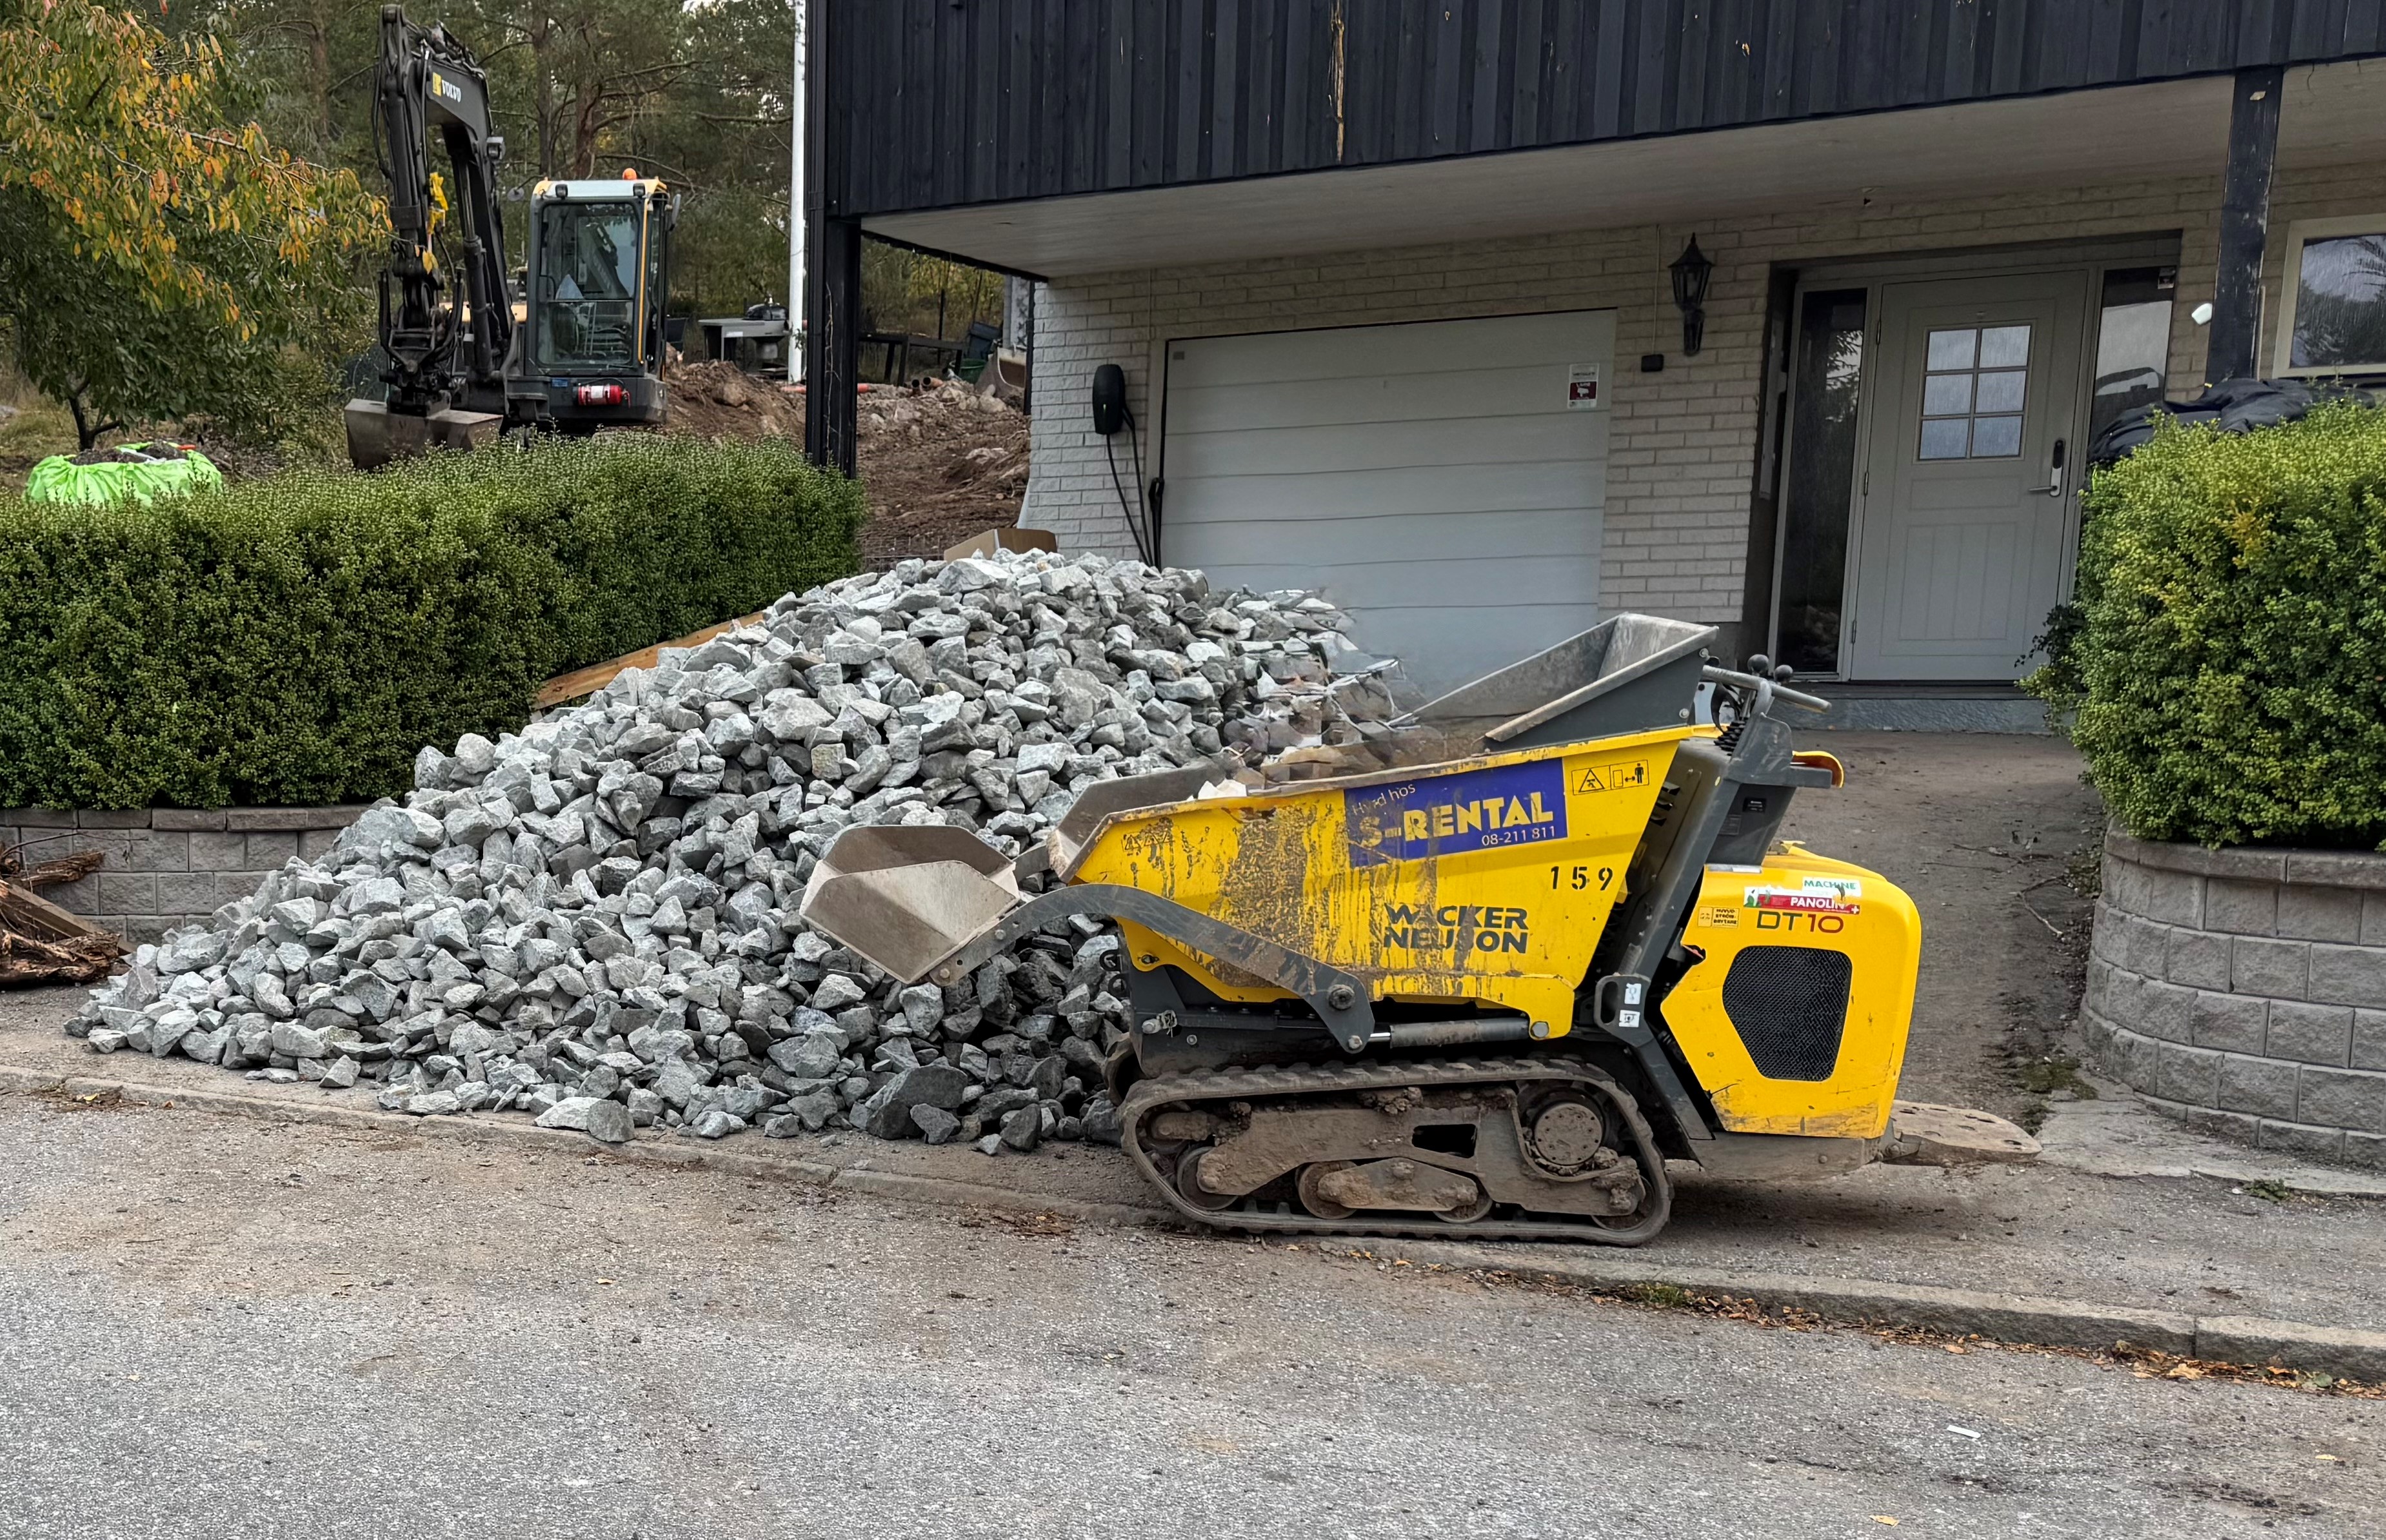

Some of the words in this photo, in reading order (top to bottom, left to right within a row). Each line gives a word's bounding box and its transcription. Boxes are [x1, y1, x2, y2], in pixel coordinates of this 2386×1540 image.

[1351, 793, 1387, 815] Hrd
[1388, 784, 1417, 801] hos
[1359, 791, 1554, 847] S-RENTAL
[1481, 829, 1527, 846] 08-211
[1531, 825, 1555, 839] 811
[1804, 880, 1856, 890] MACHNE
[1790, 896, 1845, 910] PANOLIN
[1383, 926, 1529, 954] NEUON
